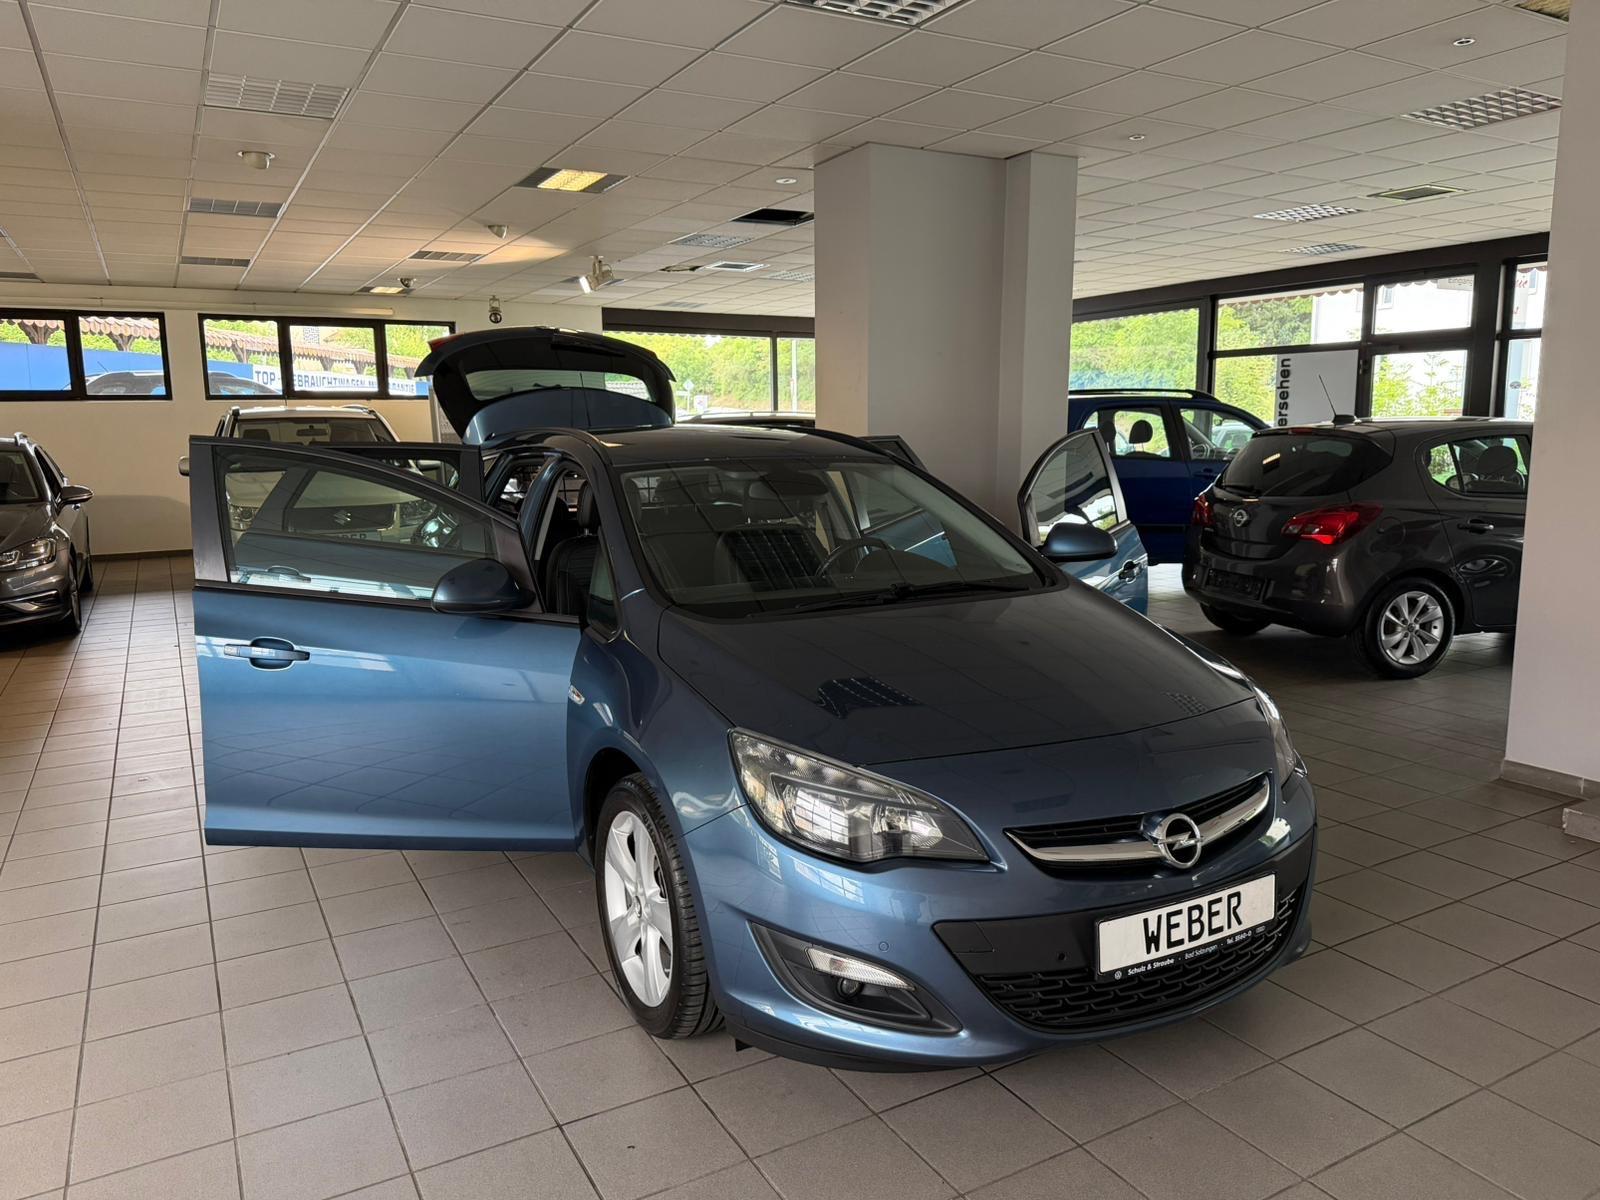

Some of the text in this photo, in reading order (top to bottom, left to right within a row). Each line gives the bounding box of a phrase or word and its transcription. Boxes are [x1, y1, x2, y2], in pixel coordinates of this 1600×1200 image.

[255, 371, 276, 385] TOP
[1143, 891, 1242, 955] WEBER
[1127, 965, 1146, 976] Schulz
